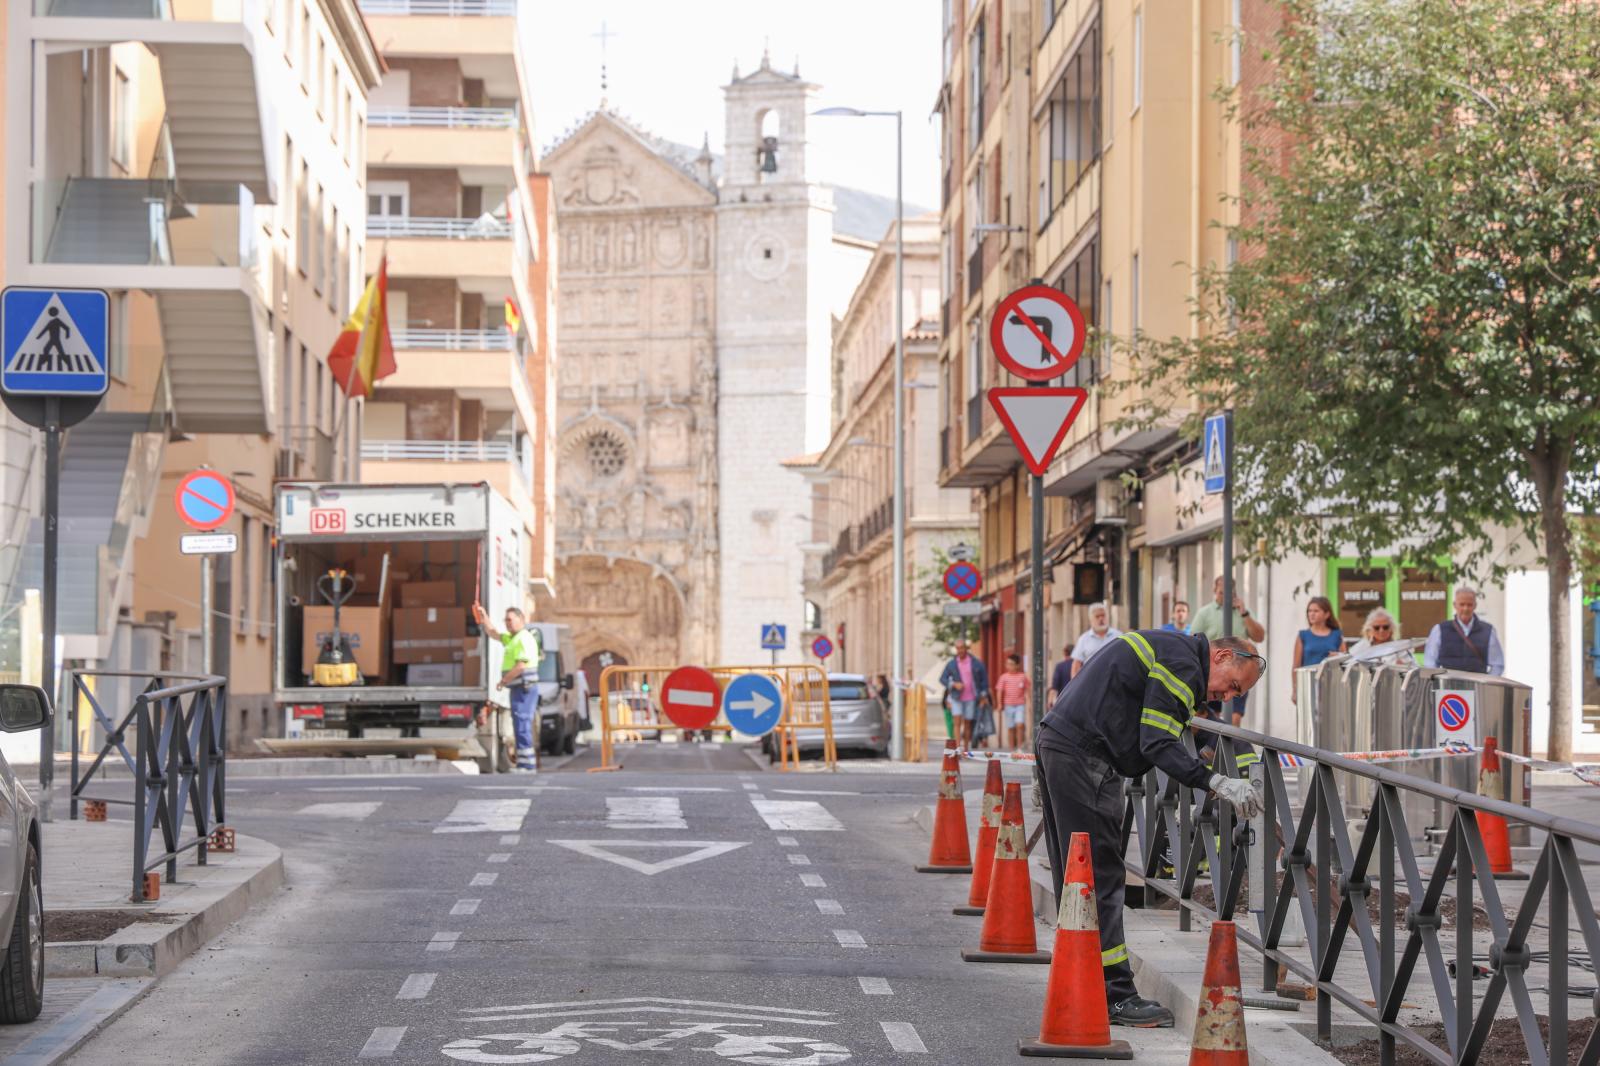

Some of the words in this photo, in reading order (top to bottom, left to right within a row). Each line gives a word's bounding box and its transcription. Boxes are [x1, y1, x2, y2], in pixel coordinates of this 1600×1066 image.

[314, 513, 341, 528] DB
[354, 512, 456, 528] SCHENKER
[1344, 591, 1361, 600] VIVE
[1362, 590, 1379, 600] MÁS
[1401, 591, 1418, 600] VIVE
[1420, 591, 1446, 600] MEJOR
